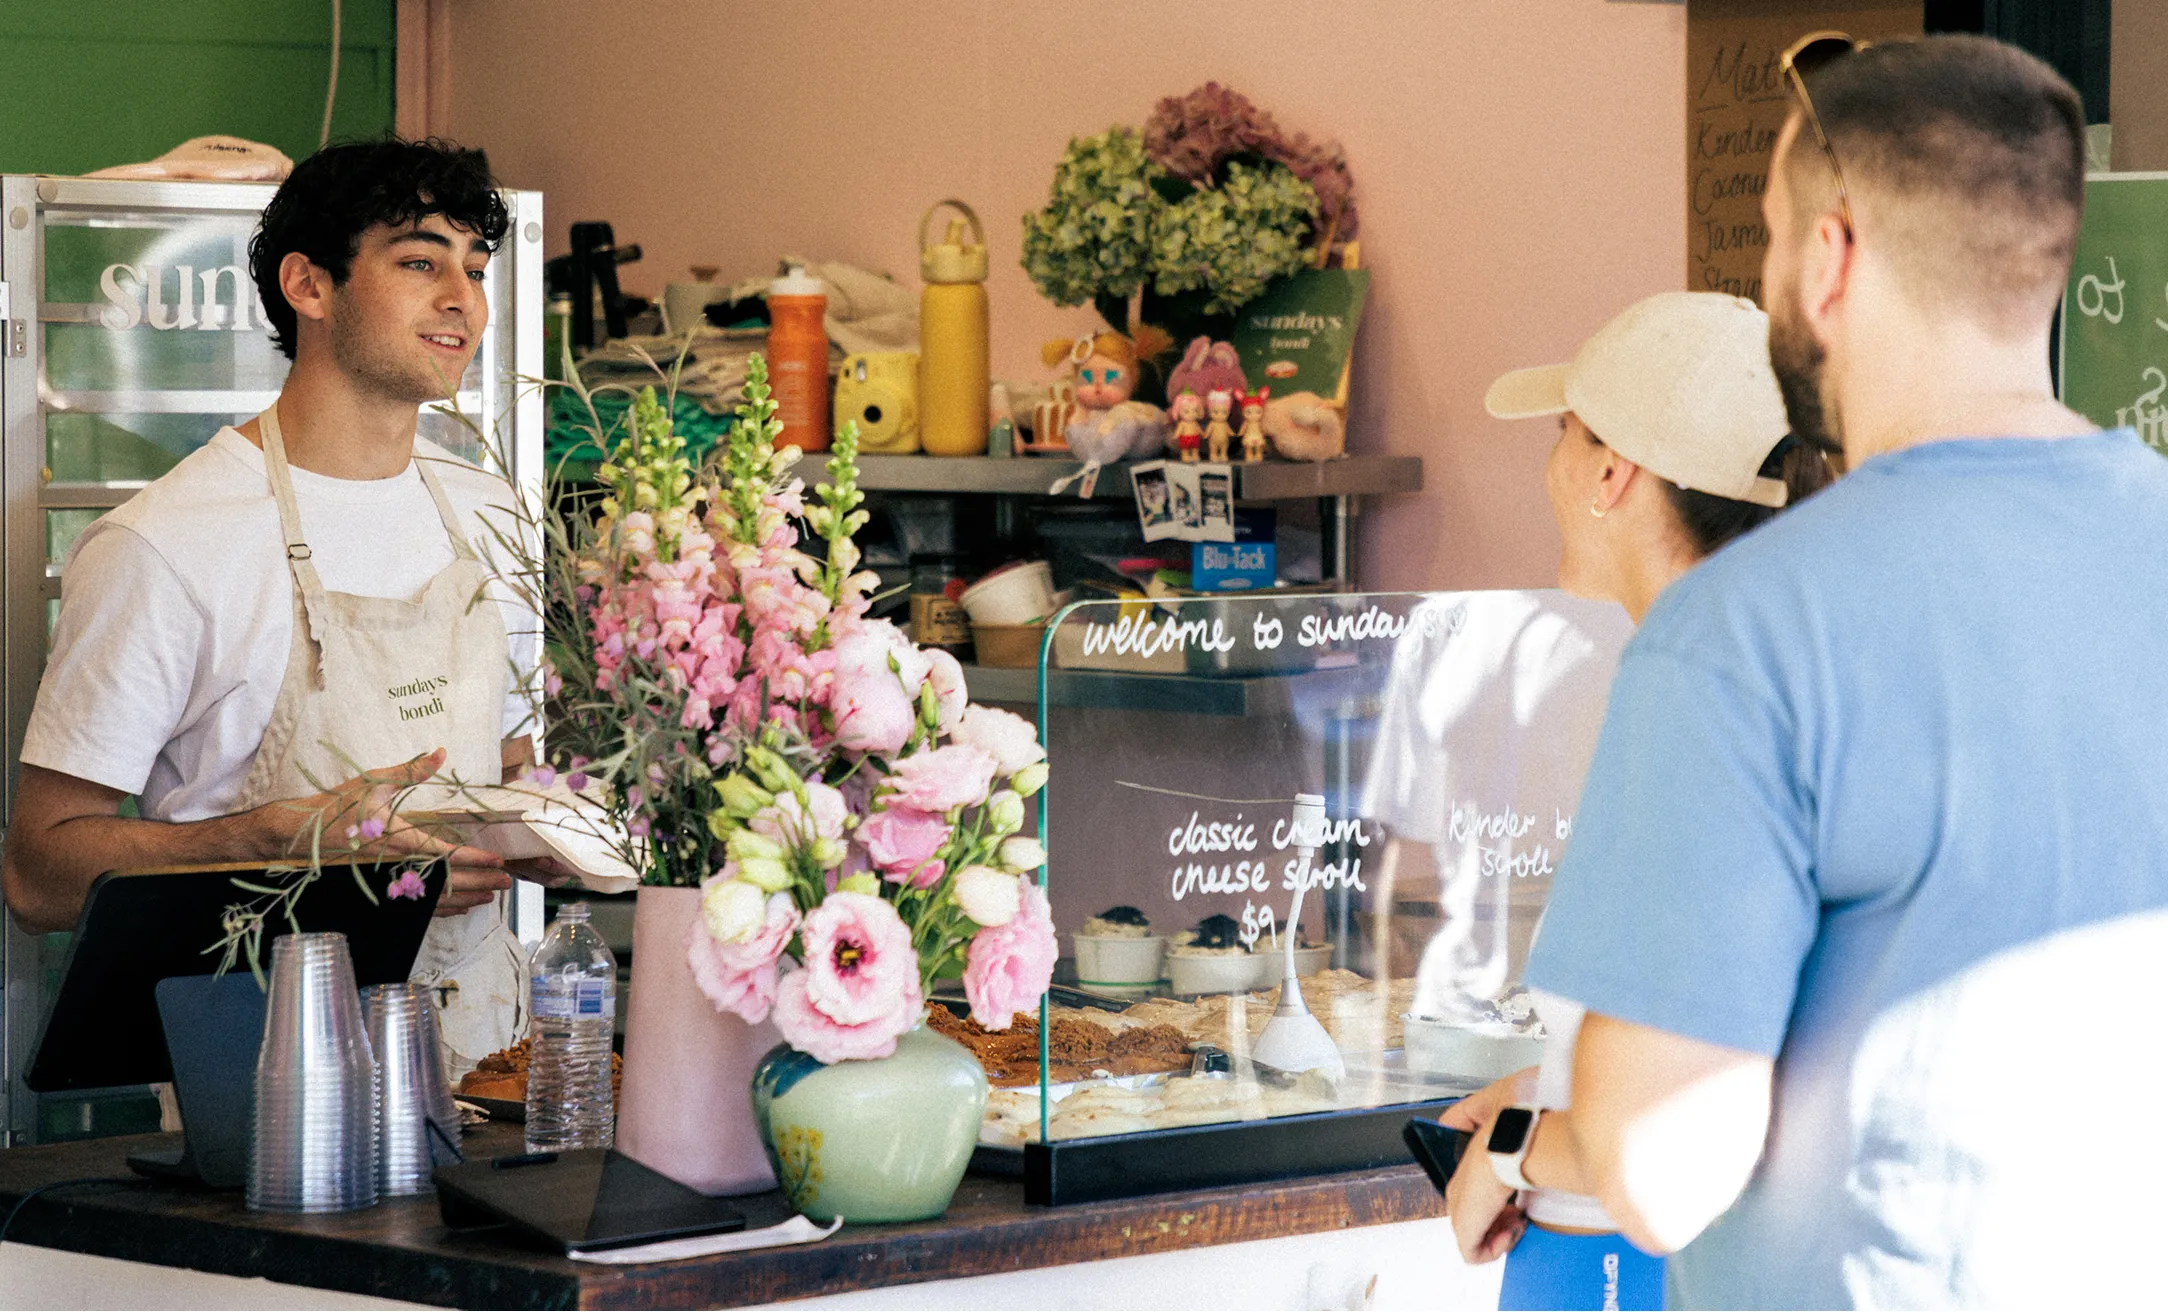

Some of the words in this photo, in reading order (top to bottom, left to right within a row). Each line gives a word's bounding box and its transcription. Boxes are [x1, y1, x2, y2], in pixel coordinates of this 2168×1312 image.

[1699, 41, 1786, 102] Mat
[1203, 545, 1266, 570] Blu-Tack
[1083, 608, 1236, 659] welcome
[1253, 611, 1284, 651] to
[388, 675, 448, 699] sundays
[399, 697, 444, 721] bondi
[1169, 811, 1257, 857] classic
[1272, 817, 1371, 850] cream
[1450, 800, 1536, 842] kinder
[1172, 860, 1270, 901] cheese
[1282, 858, 1367, 893] scroll
[1481, 843, 1553, 878] scroll
[1239, 899, 1277, 953] $9
